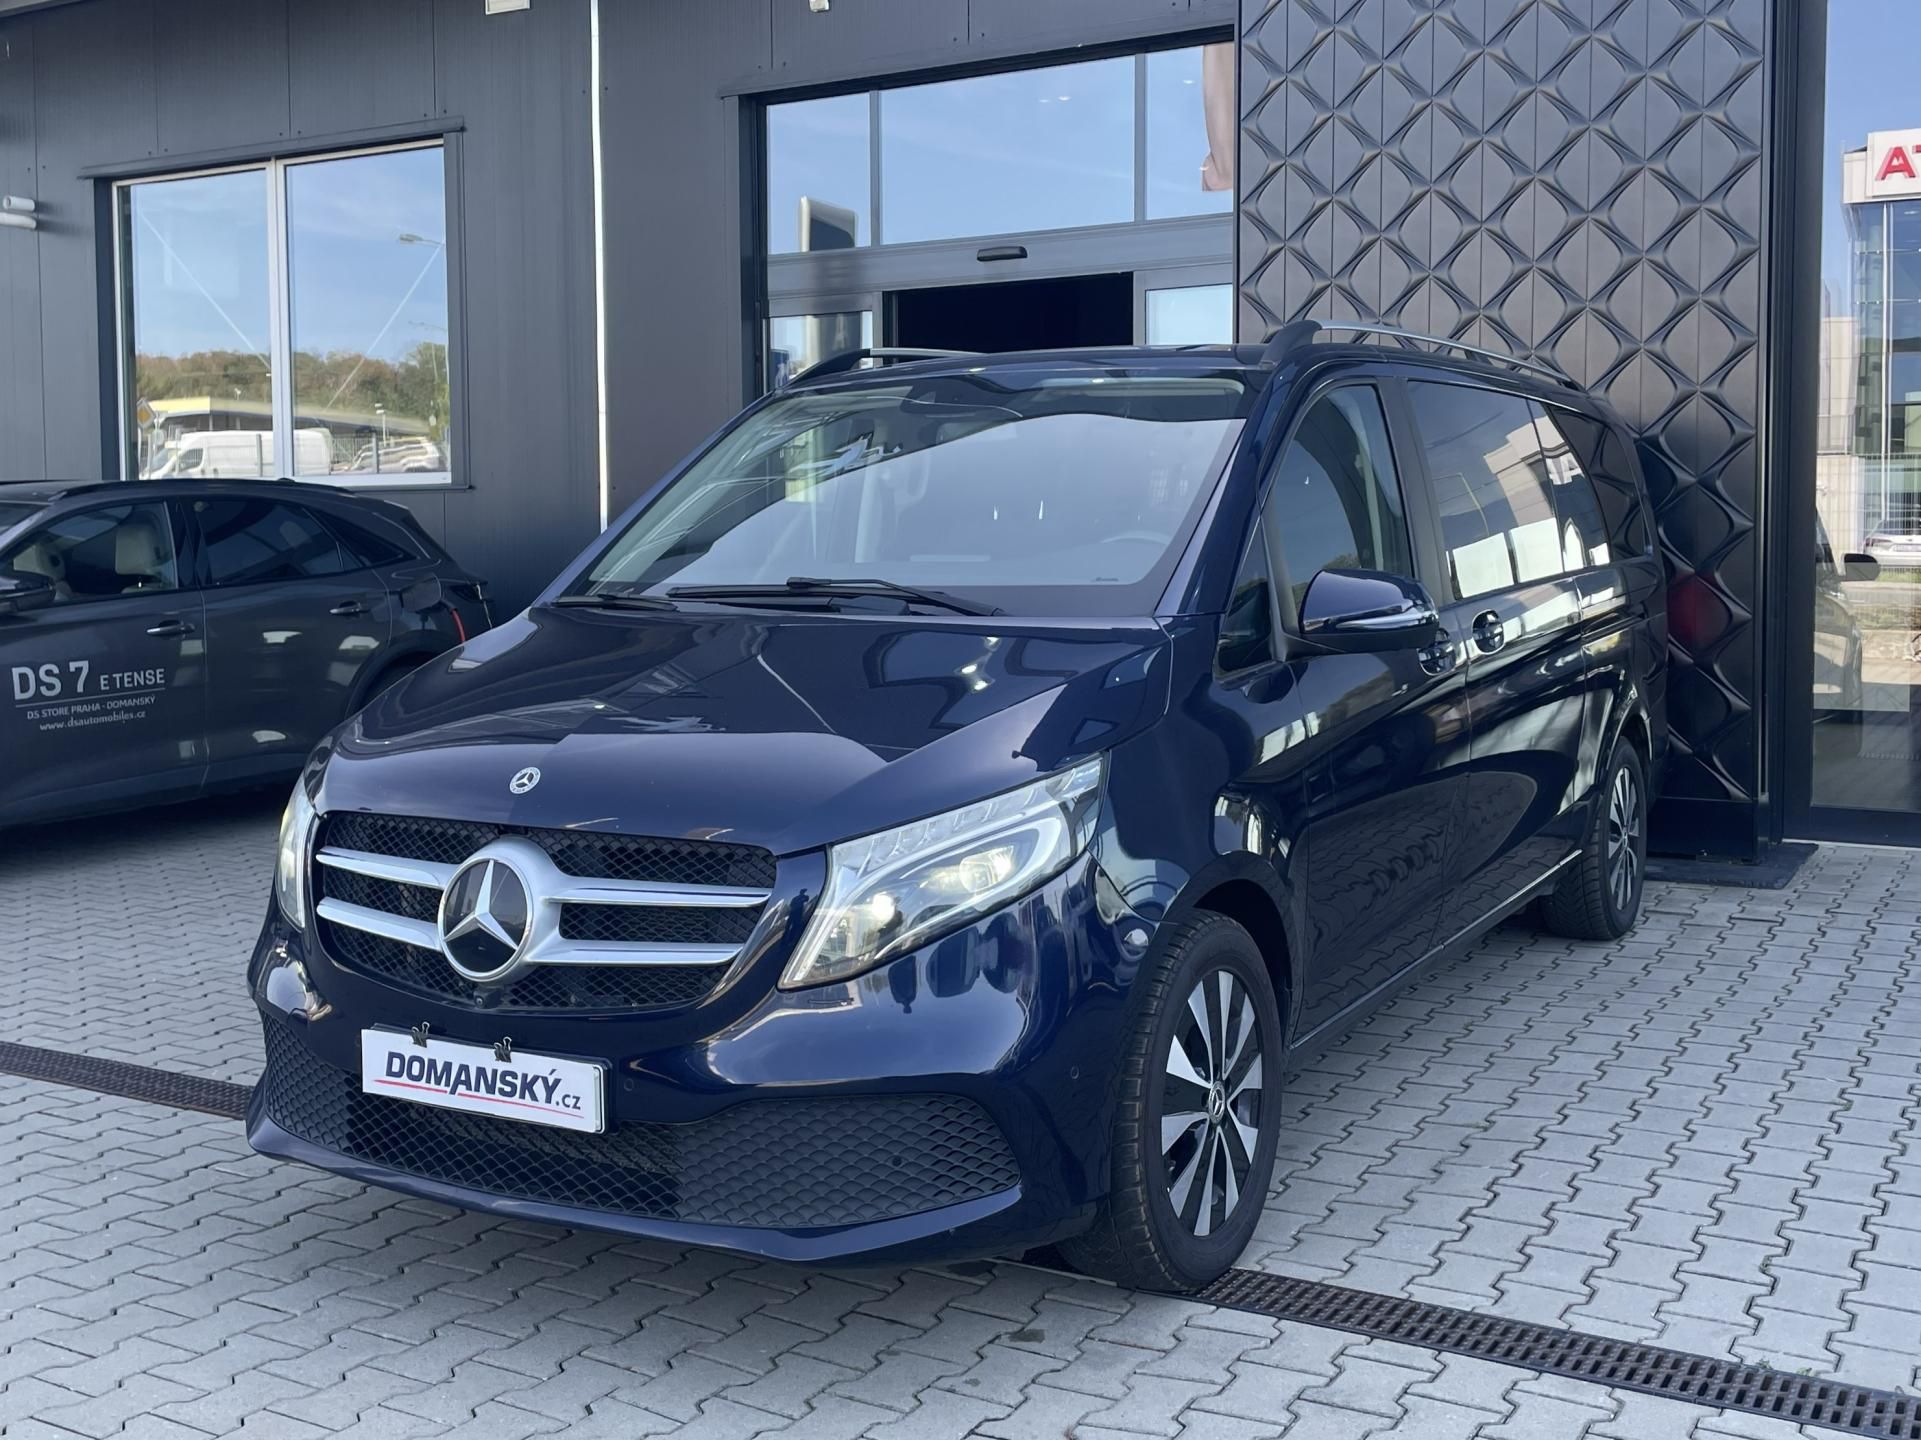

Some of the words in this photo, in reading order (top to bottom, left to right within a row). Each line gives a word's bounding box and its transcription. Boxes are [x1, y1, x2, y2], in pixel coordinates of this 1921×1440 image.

[11, 663, 62, 700] DS
[69, 660, 89, 693] 7
[100, 674, 110, 690] E
[112, 668, 165, 689] TENSE
[27, 710, 40, 720] DS
[41, 706, 69, 718] STORE
[71, 703, 101, 714] PRAHA
[40, 710, 146, 731] www.dsautomobiles.cz
